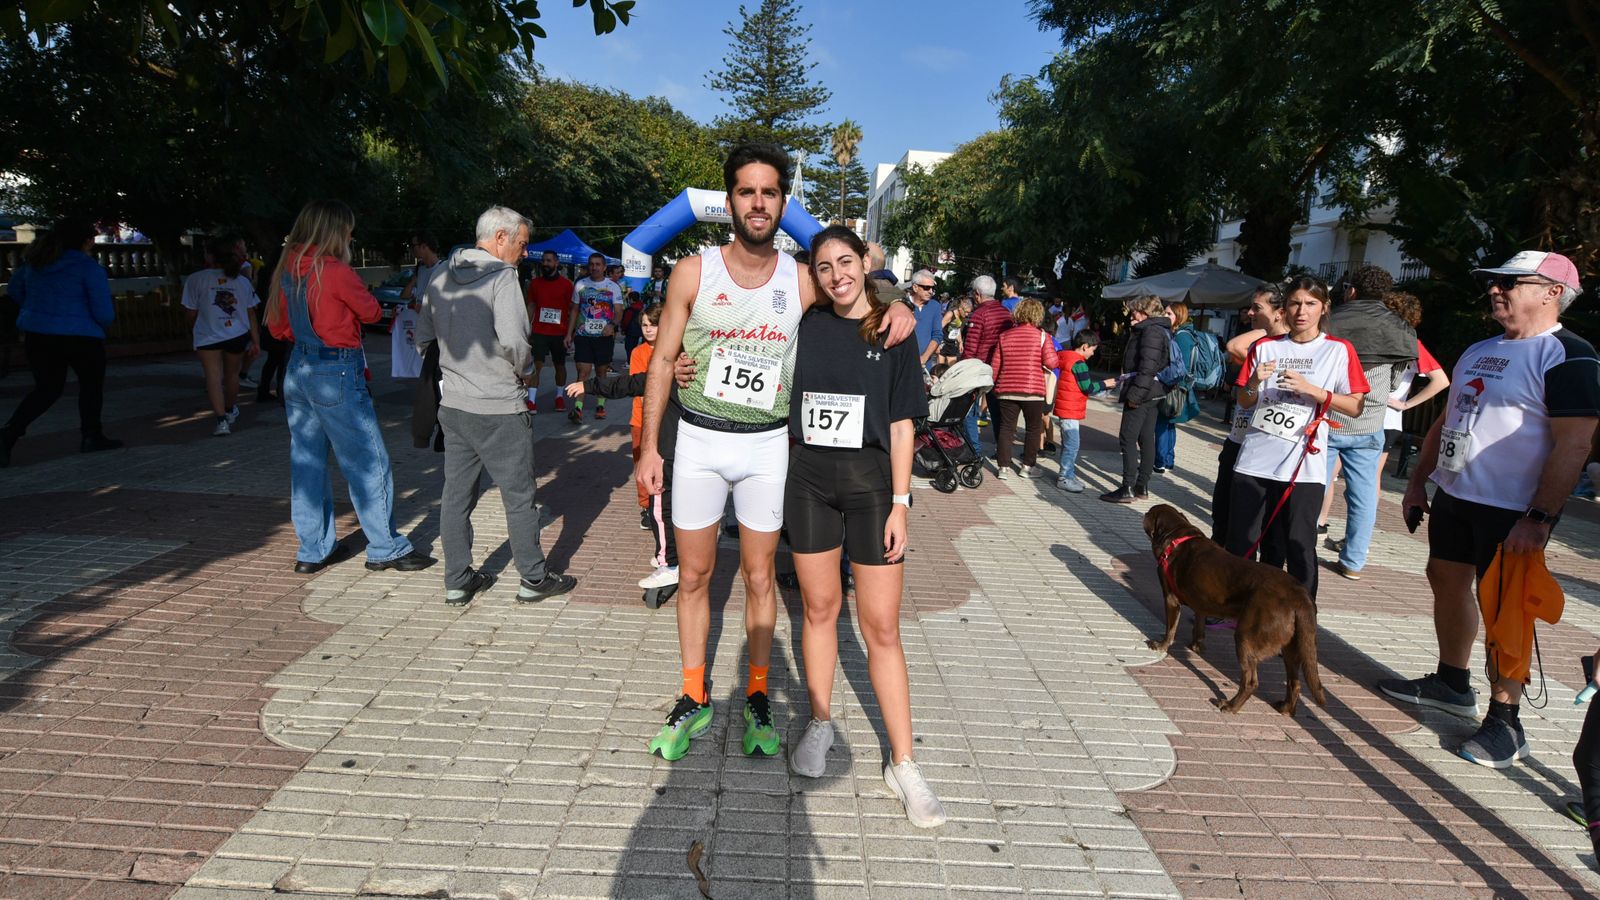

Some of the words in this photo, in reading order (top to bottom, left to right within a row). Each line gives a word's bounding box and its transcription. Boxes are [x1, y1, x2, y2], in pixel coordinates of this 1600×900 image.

[544, 311, 556, 319] 221
[710, 323, 787, 342] maratón
[730, 344, 767, 352] JEREZ
[748, 355, 779, 367] SILVESTRE
[1480, 356, 1510, 367] CARRERA
[1480, 364, 1505, 373] SILVESTRE
[721, 365, 764, 392] 156
[693, 414, 733, 429] NIKE
[808, 408, 849, 431] 157
[1263, 409, 1295, 429] 206
